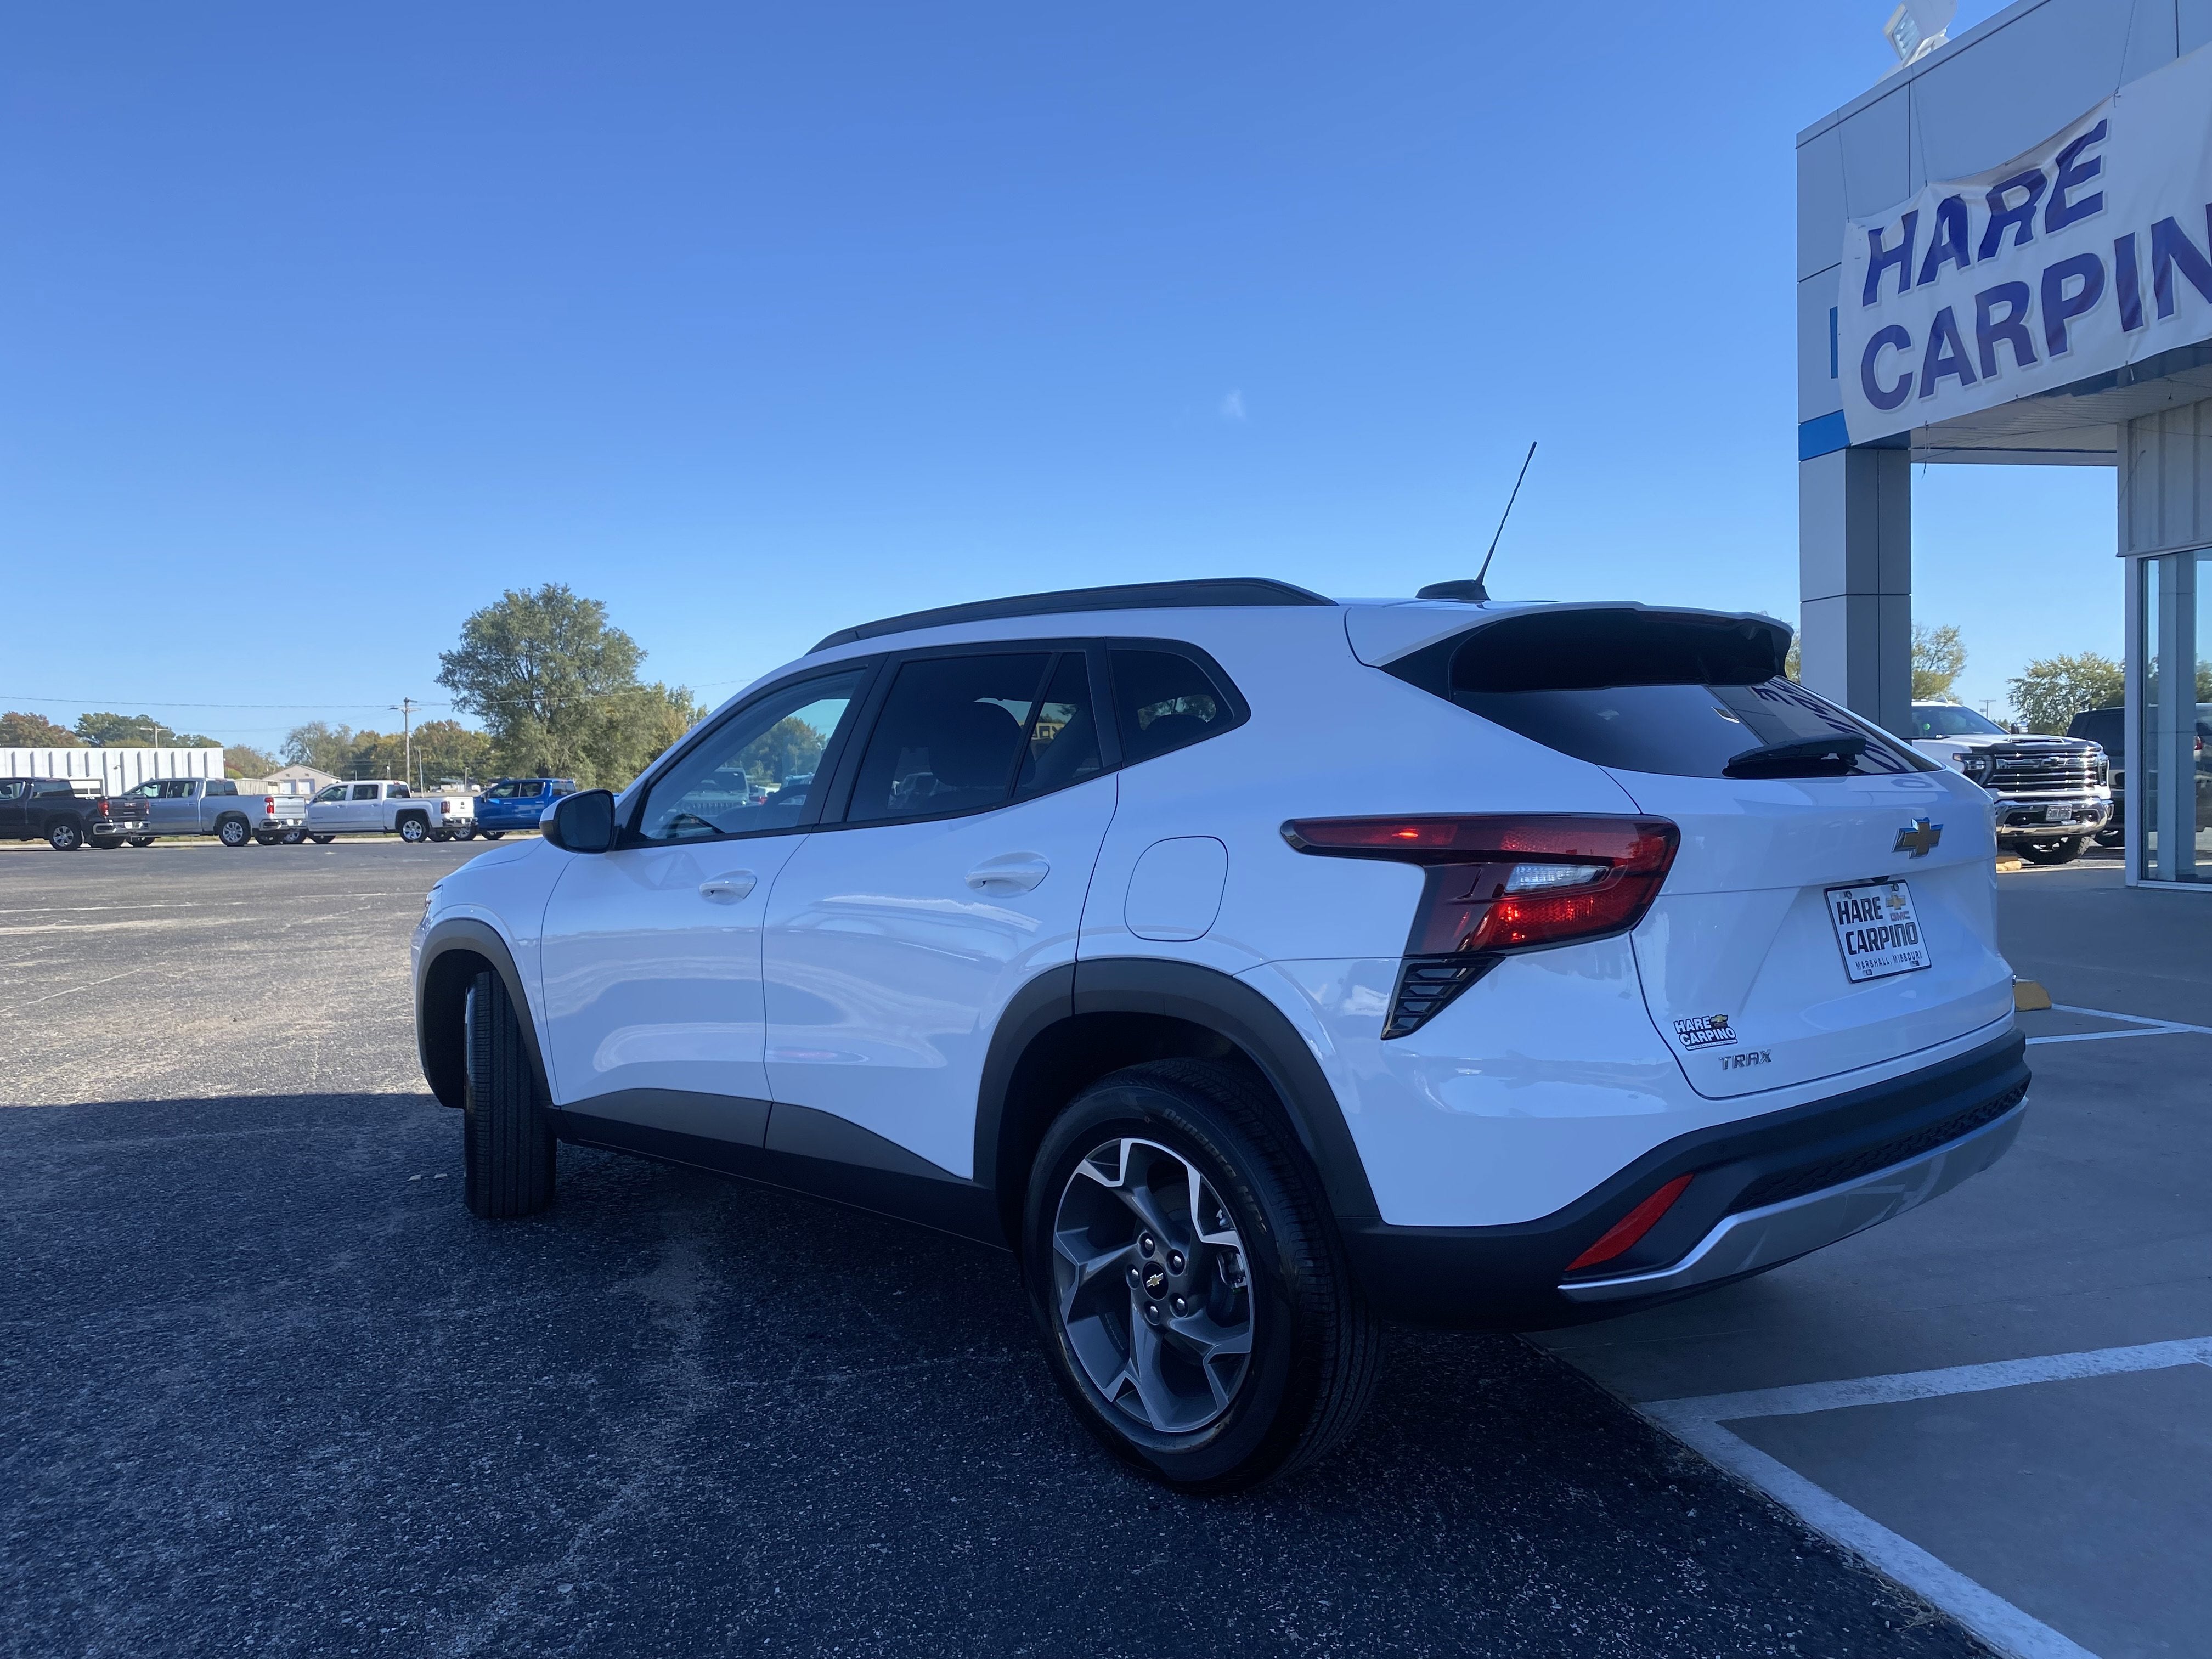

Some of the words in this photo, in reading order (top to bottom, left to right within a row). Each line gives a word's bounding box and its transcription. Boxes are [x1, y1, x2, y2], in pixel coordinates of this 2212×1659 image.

[1862, 118, 2108, 307] HARE
[1836, 896, 1883, 926] HARE
[1889, 911, 1911, 922] GMC
[1845, 922, 1919, 955] CARPINO
[1674, 1017, 1712, 1034] HARE
[1679, 1027, 1736, 1046] CARPINO
[1718, 1048, 1772, 1070] TRAX
